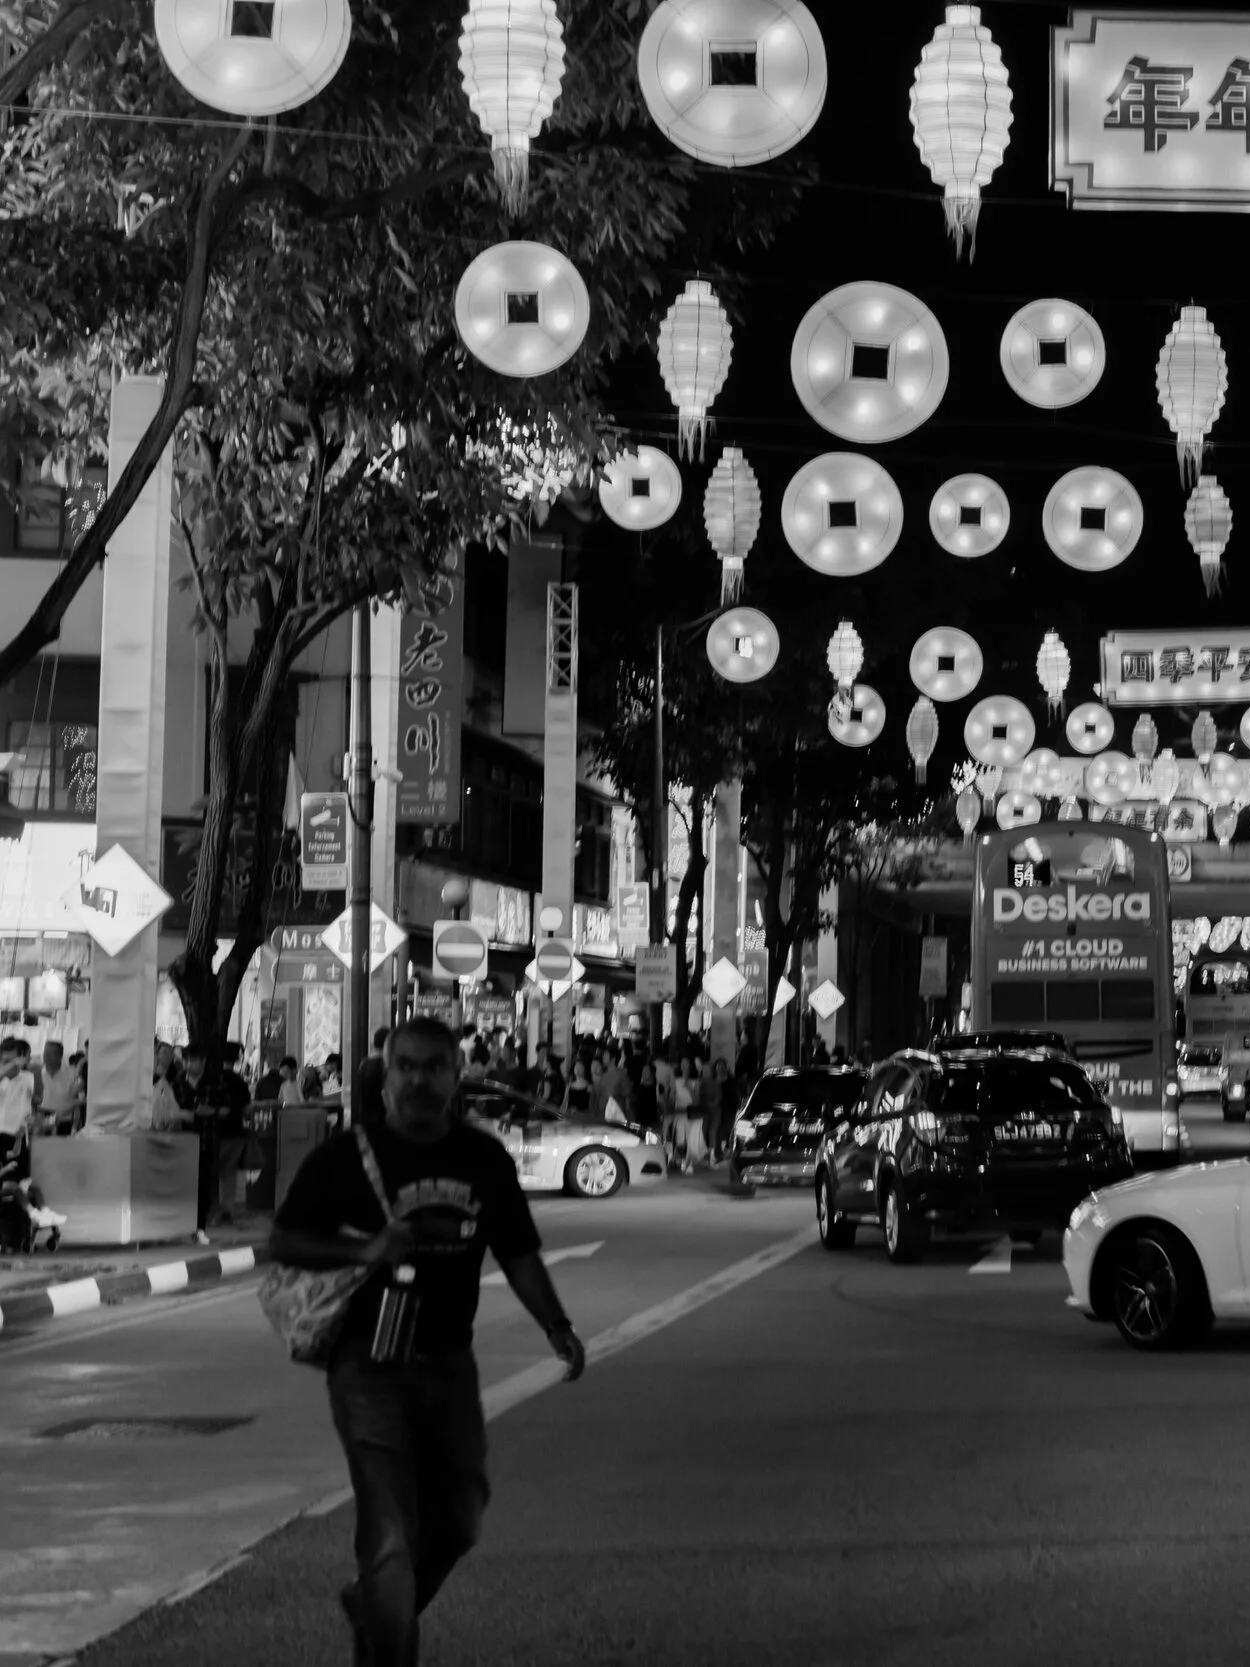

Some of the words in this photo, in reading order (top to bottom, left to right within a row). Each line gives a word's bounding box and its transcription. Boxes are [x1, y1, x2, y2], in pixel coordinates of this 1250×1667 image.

[401, 803, 434, 816] Level
[438, 804, 446, 816] 2
[1014, 863, 1034, 887] 54
[993, 885, 1150, 922] Deskera
[282, 929, 322, 949] Mos
[1021, 940, 1046, 957] #1
[1050, 939, 1123, 957] CLOUD
[998, 958, 1067, 972] BUSINESS
[1070, 957, 1147, 971] SOFTWARE
[1118, 1079, 1153, 1096] THE
